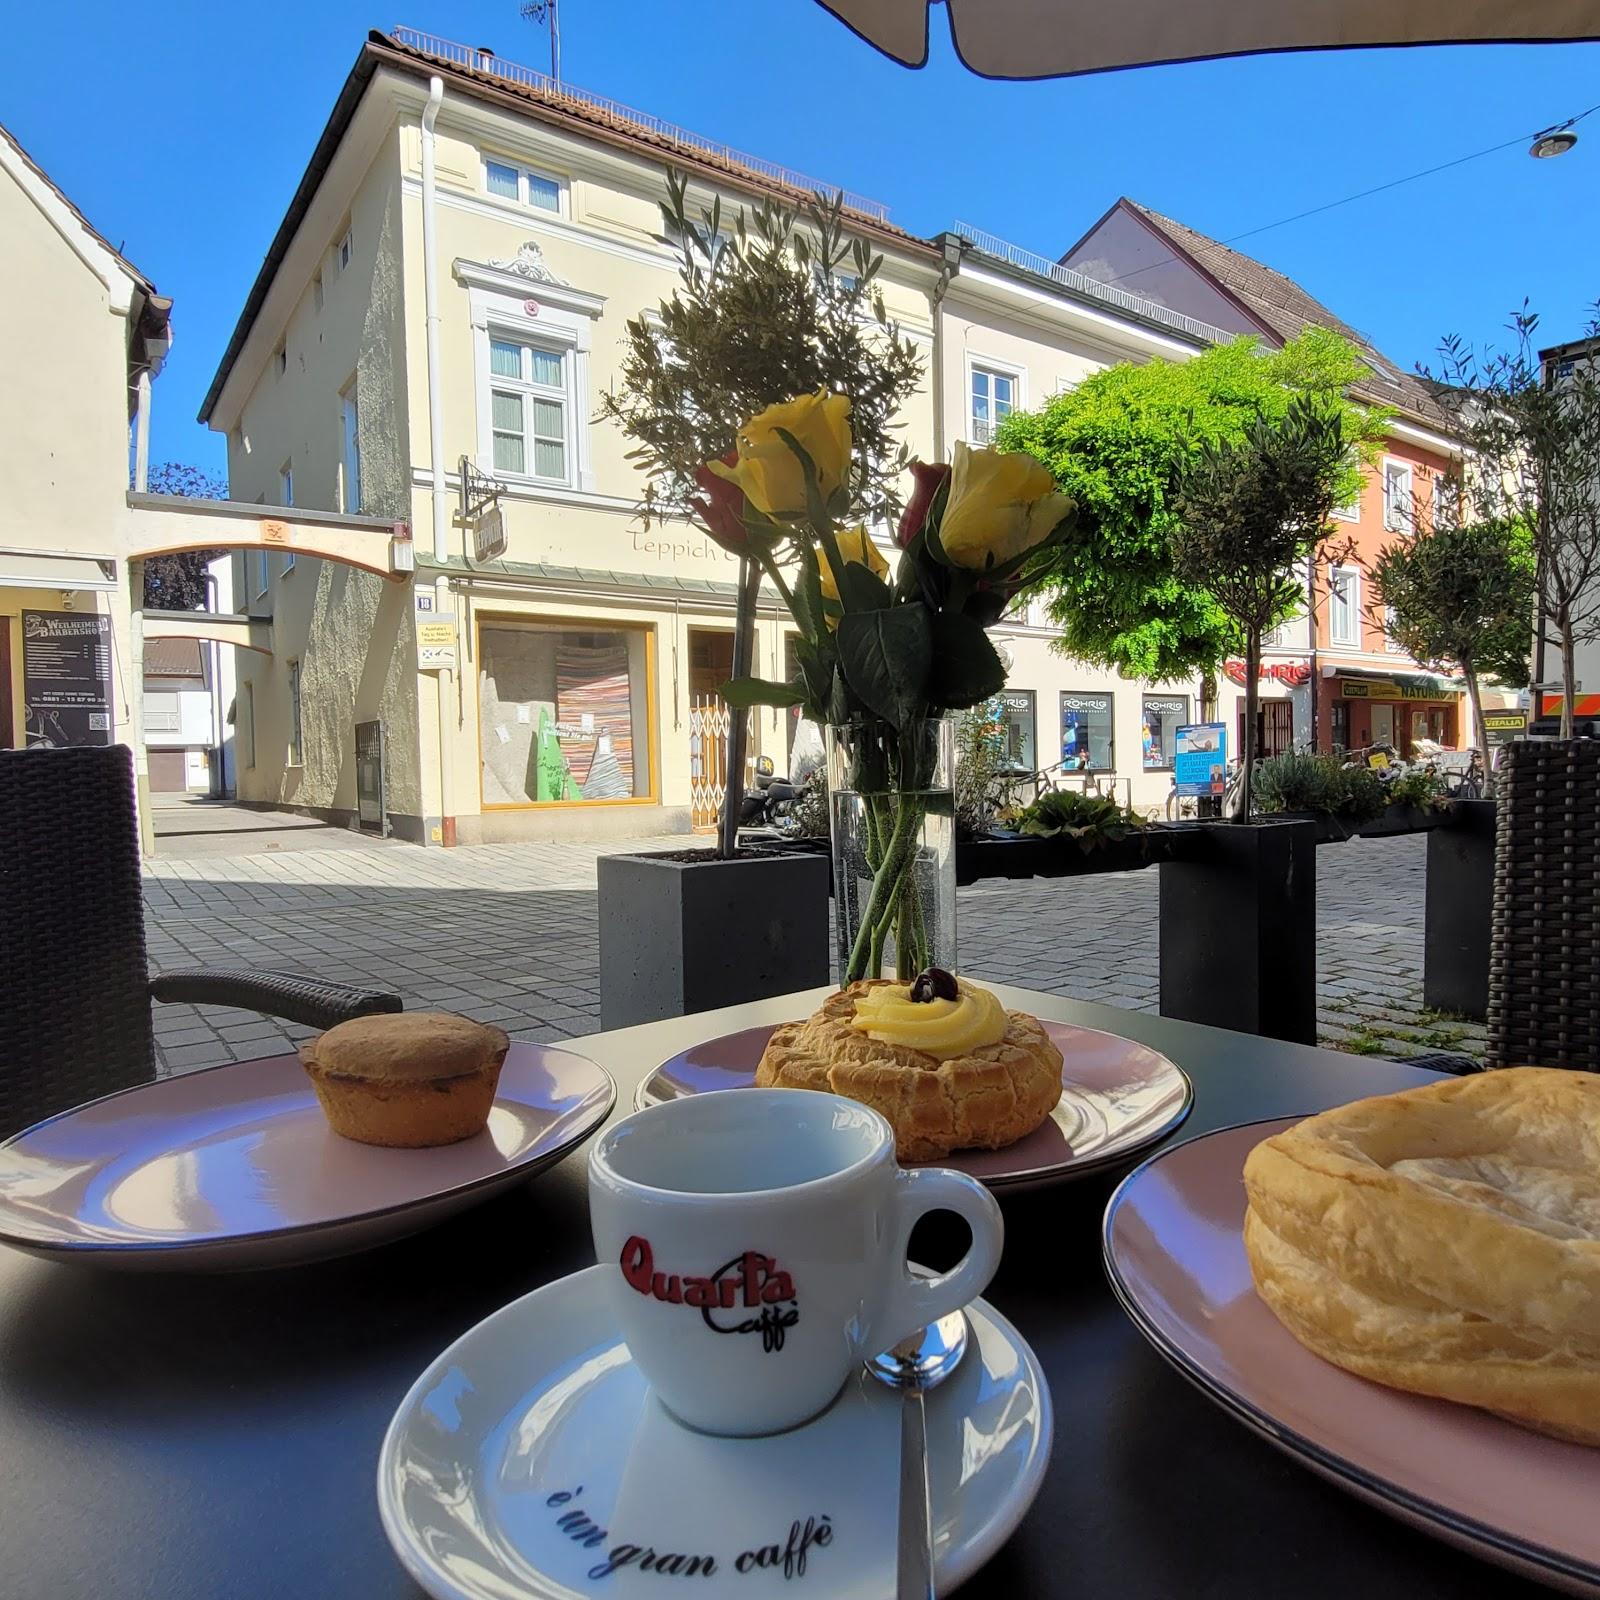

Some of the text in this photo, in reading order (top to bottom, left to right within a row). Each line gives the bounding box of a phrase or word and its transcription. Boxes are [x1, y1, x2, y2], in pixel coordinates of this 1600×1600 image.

[625, 530, 717, 561] Teppich
[587, 1543, 718, 1580] gran
[735, 1514, 834, 1580] caffè
